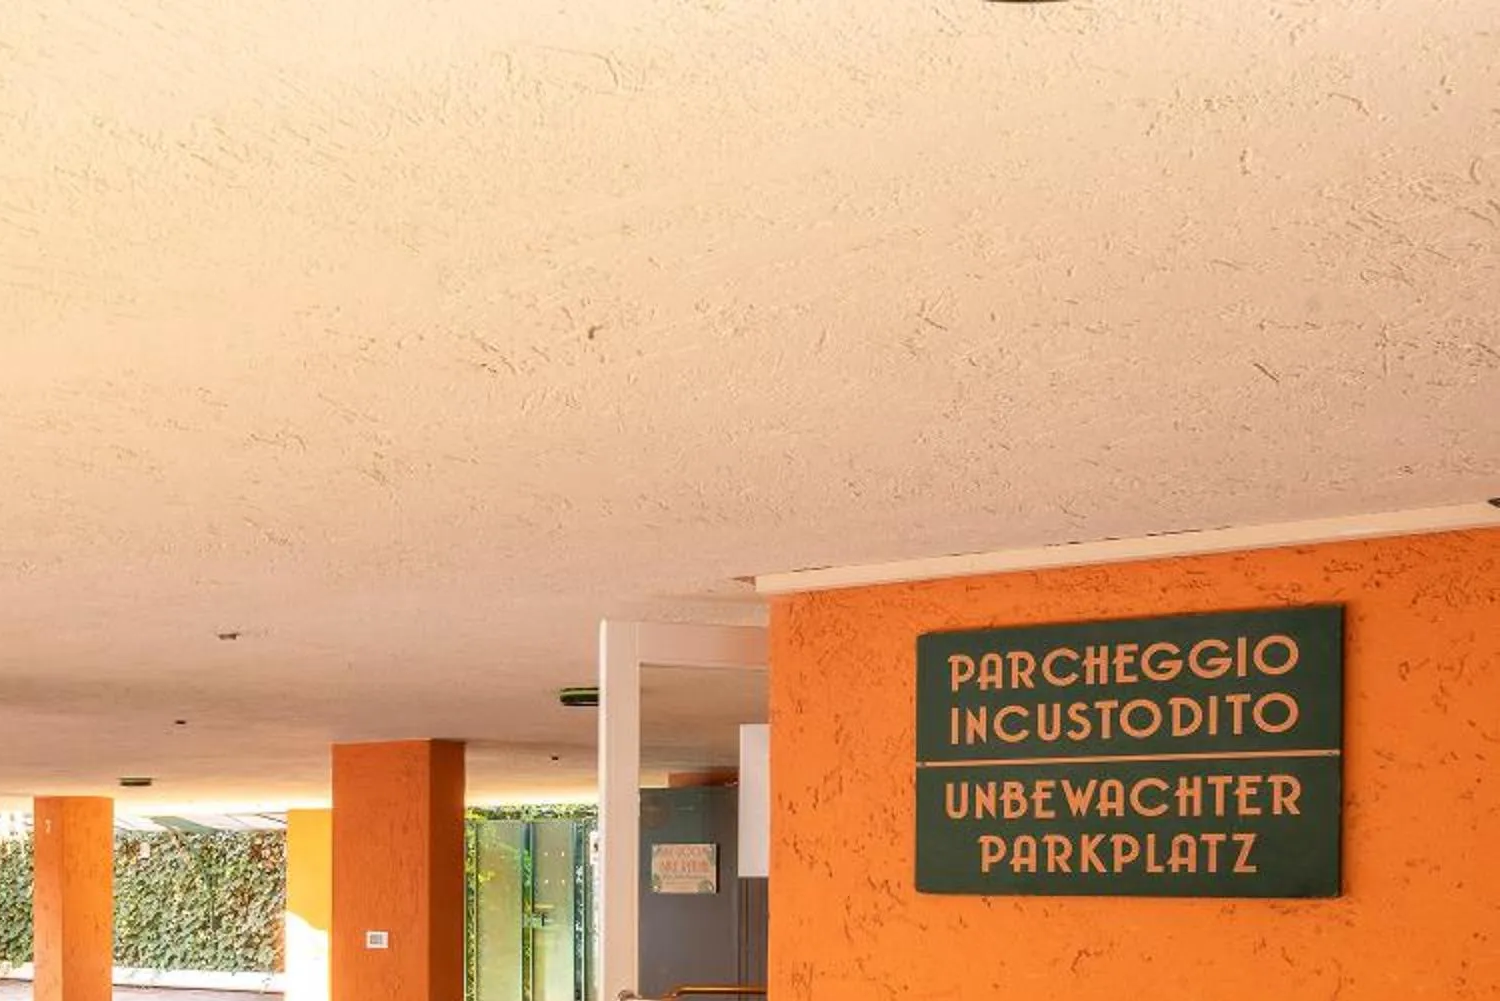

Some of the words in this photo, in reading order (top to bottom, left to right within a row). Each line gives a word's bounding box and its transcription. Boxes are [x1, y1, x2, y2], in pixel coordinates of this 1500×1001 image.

[948, 635, 1299, 692] PARCHEGGIO
[950, 693, 1299, 745] INCUSTODITO
[944, 775, 1301, 819] UNBEWACHTER
[979, 833, 1257, 873] PARKPLATZ
